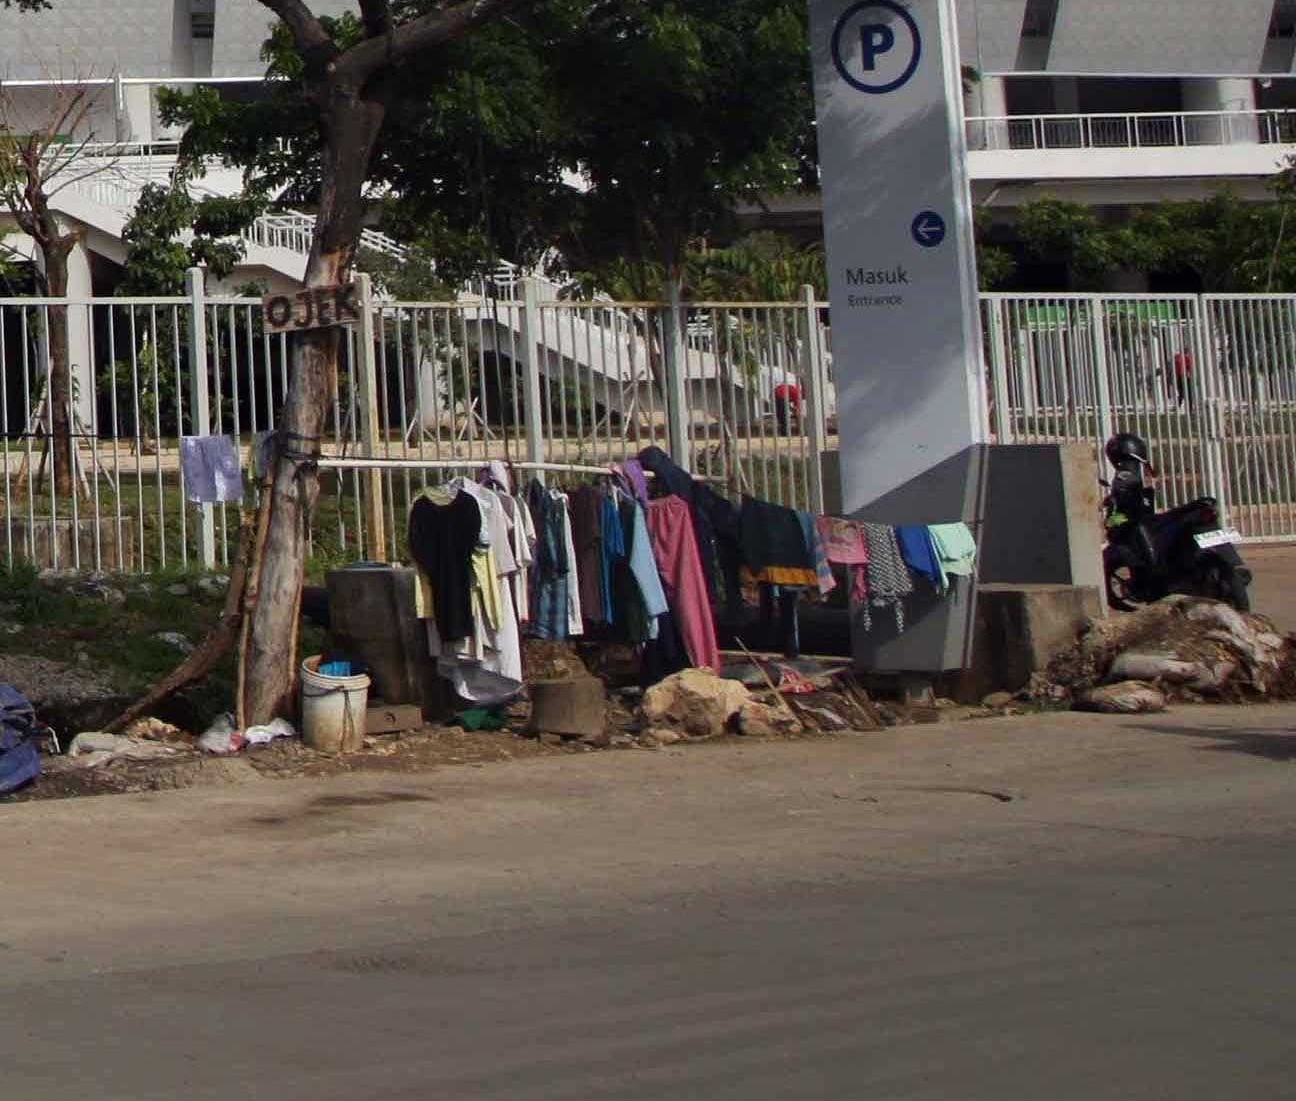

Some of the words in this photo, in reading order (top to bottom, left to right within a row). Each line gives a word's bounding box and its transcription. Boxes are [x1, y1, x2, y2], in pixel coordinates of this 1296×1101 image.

[860, 24, 894, 71] P
[846, 264, 909, 284] Masuk
[268, 293, 359, 327] OJEK
[848, 295, 903, 306] Entrance
